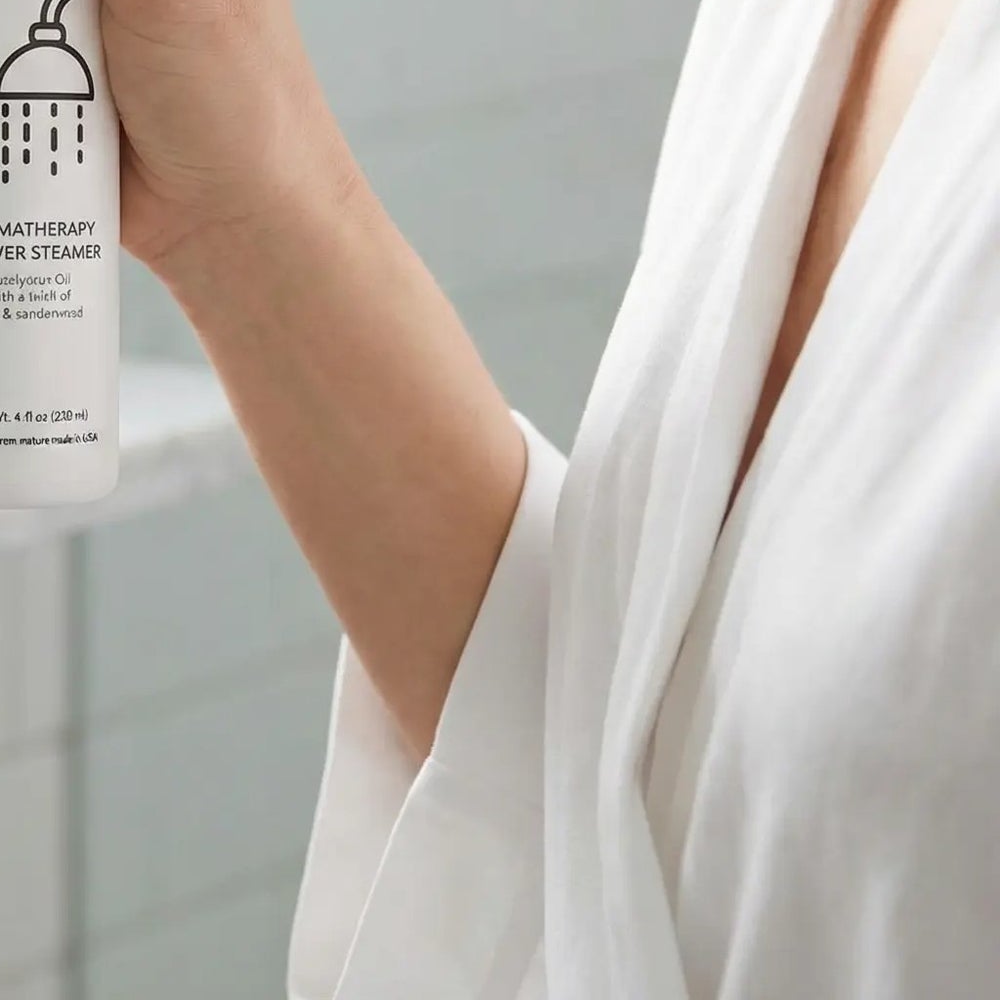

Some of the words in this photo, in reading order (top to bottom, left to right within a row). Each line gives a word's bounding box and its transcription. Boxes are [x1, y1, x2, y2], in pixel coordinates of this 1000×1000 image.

[31, 244, 102, 260] STEAMER
[18, 293, 25, 302] a
[59, 289, 72, 301] of
[2, 307, 12, 319] &
